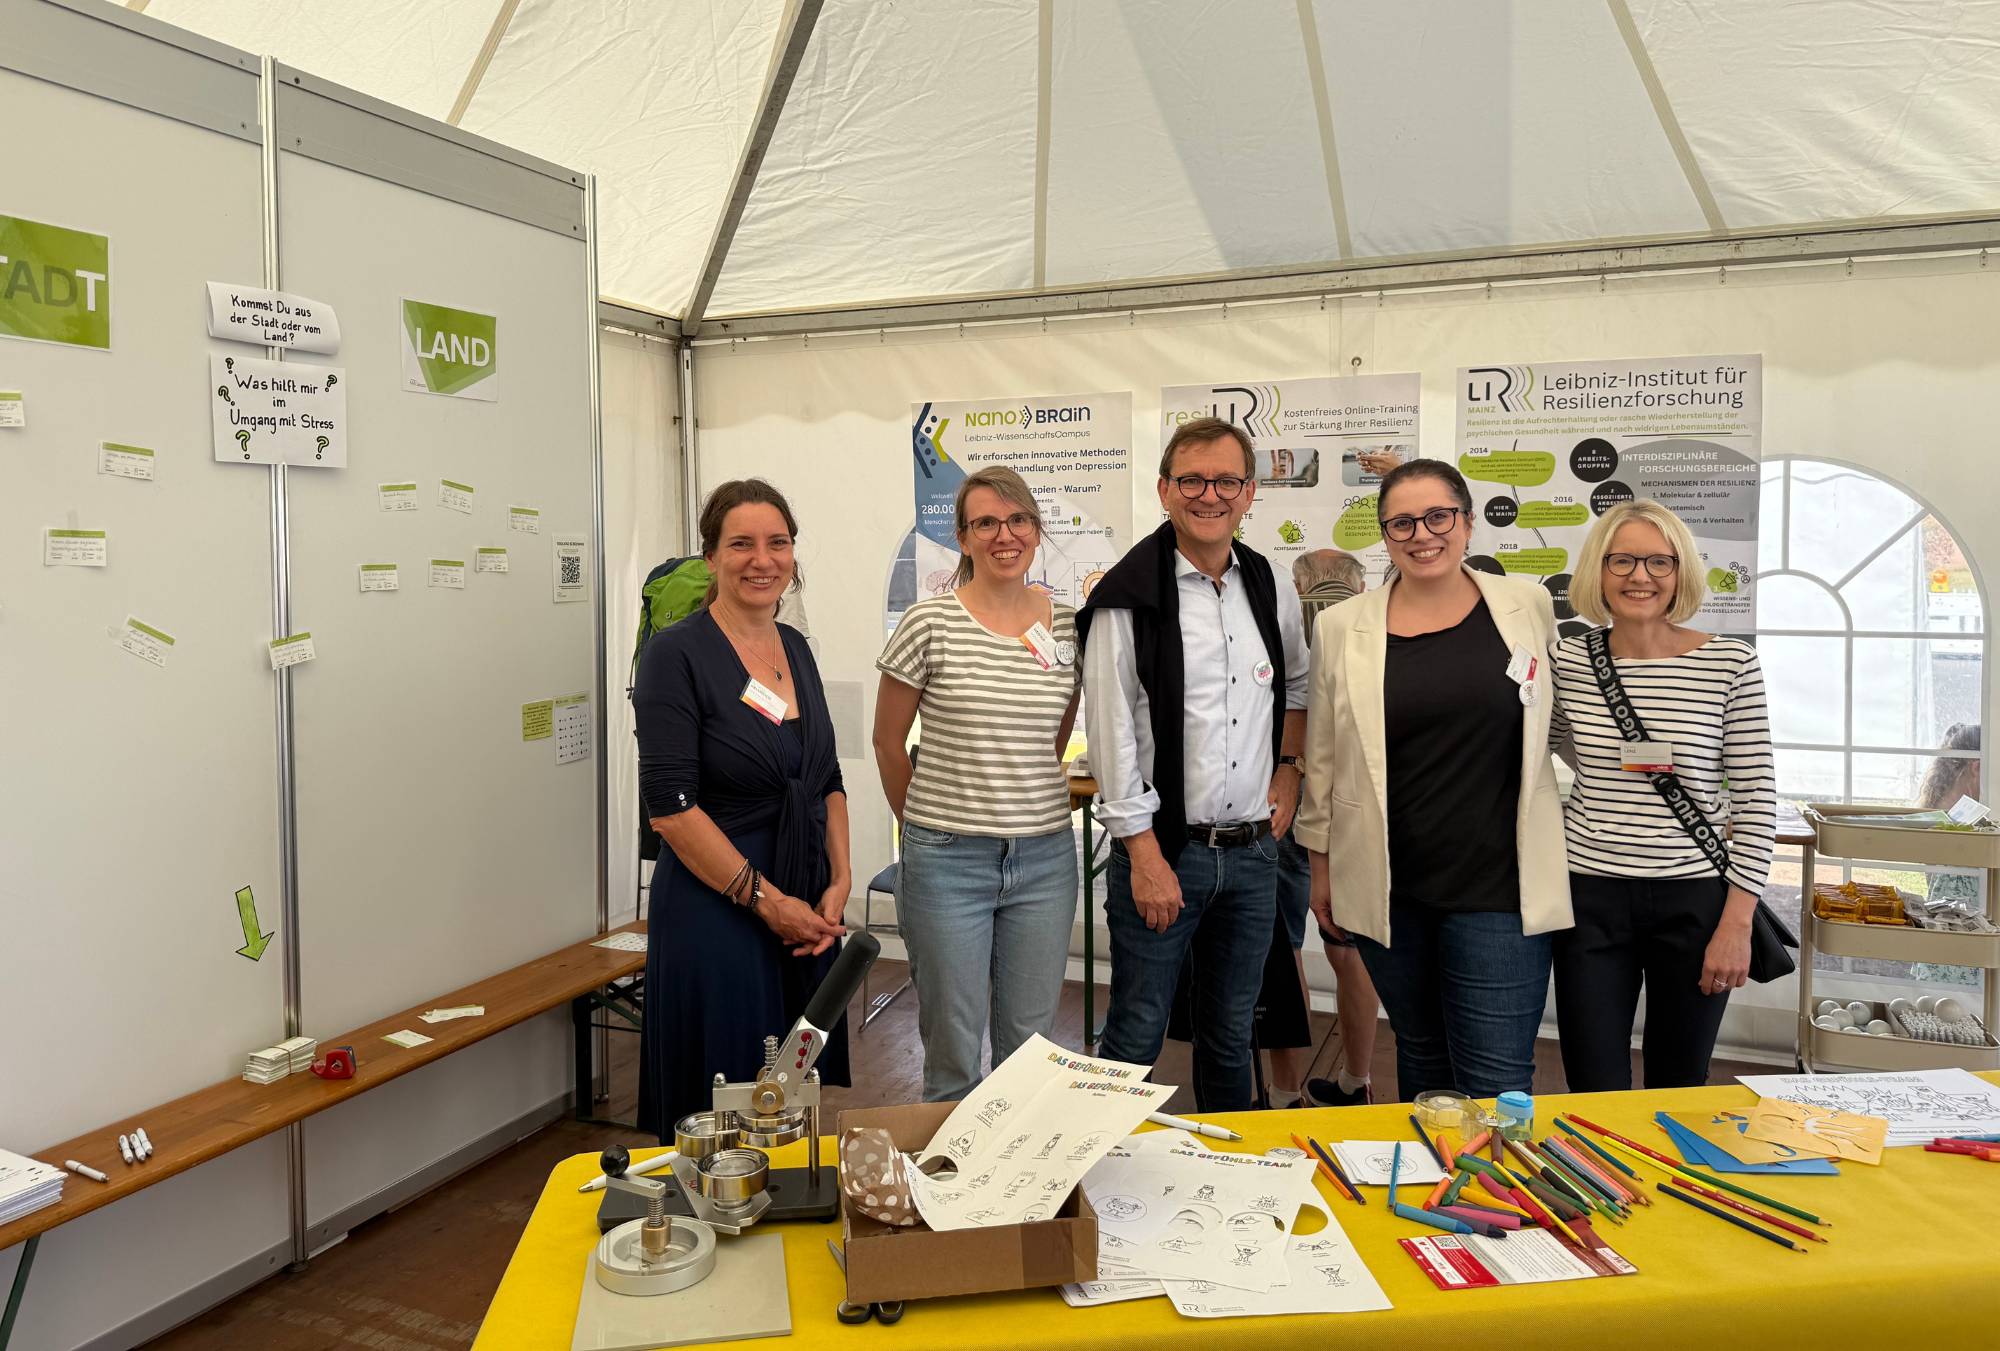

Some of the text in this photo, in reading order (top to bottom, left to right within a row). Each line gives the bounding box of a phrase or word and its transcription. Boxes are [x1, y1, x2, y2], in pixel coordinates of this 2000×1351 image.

[0, 255, 106, 312] ADT
[230, 293, 312, 318] Kommst Du aus
[230, 312, 321, 334] der Stadt oder vom
[416, 327, 490, 367] LAND
[235, 374, 268, 390] Was
[272, 378, 298, 393] hilft
[300, 383, 318, 394] mir
[1543, 366, 1748, 391] Leibniz-Institut für
[272, 396, 286, 408] im
[1543, 389, 1744, 412] Resilienzforschung
[1284, 404, 1419, 418] Kostenfreies Online-Training
[1467, 406, 1497, 414] MAINZ
[230, 408, 334, 435] Umgang mit Stress
[1283, 418, 1414, 432] zur Stärkung Ihrer Resilienz
[1466, 410, 1738, 427] Resilienz ist die Aufrechterhaltung oder rasche Wiederherstellung der
[964, 429, 1091, 443] Leibniz-WissenschaftsCampus
[1466, 428, 1513, 439] psychischen
[1514, 427, 1559, 436] Gesundheit
[1561, 426, 1595, 434] während
[1597, 425, 1612, 433] und
[1614, 424, 1632, 432] nach
[1634, 423, 1670, 434] widrigen
[967, 448, 1126, 462] Wir erforschen innovative Methoden
[1622, 451, 1718, 462] INTERDISZIPLINÄRE
[1009, 464, 1054, 474] handlung
[1075, 462, 1126, 474] Depression
[1639, 464, 1756, 474] FORSCHUNGSBEREICHE
[1030, 486, 1056, 495] rapien
[1064, 484, 1101, 494] Warum?
[921, 504, 955, 514] 280.00
[1615, 705, 1642, 742] UGO
[1694, 825, 1725, 868] UGO
[1048, 1052, 1068, 1066] DAS
[1069, 1080, 1088, 1090] DAS
[1170, 1148, 1194, 1156] DAS
